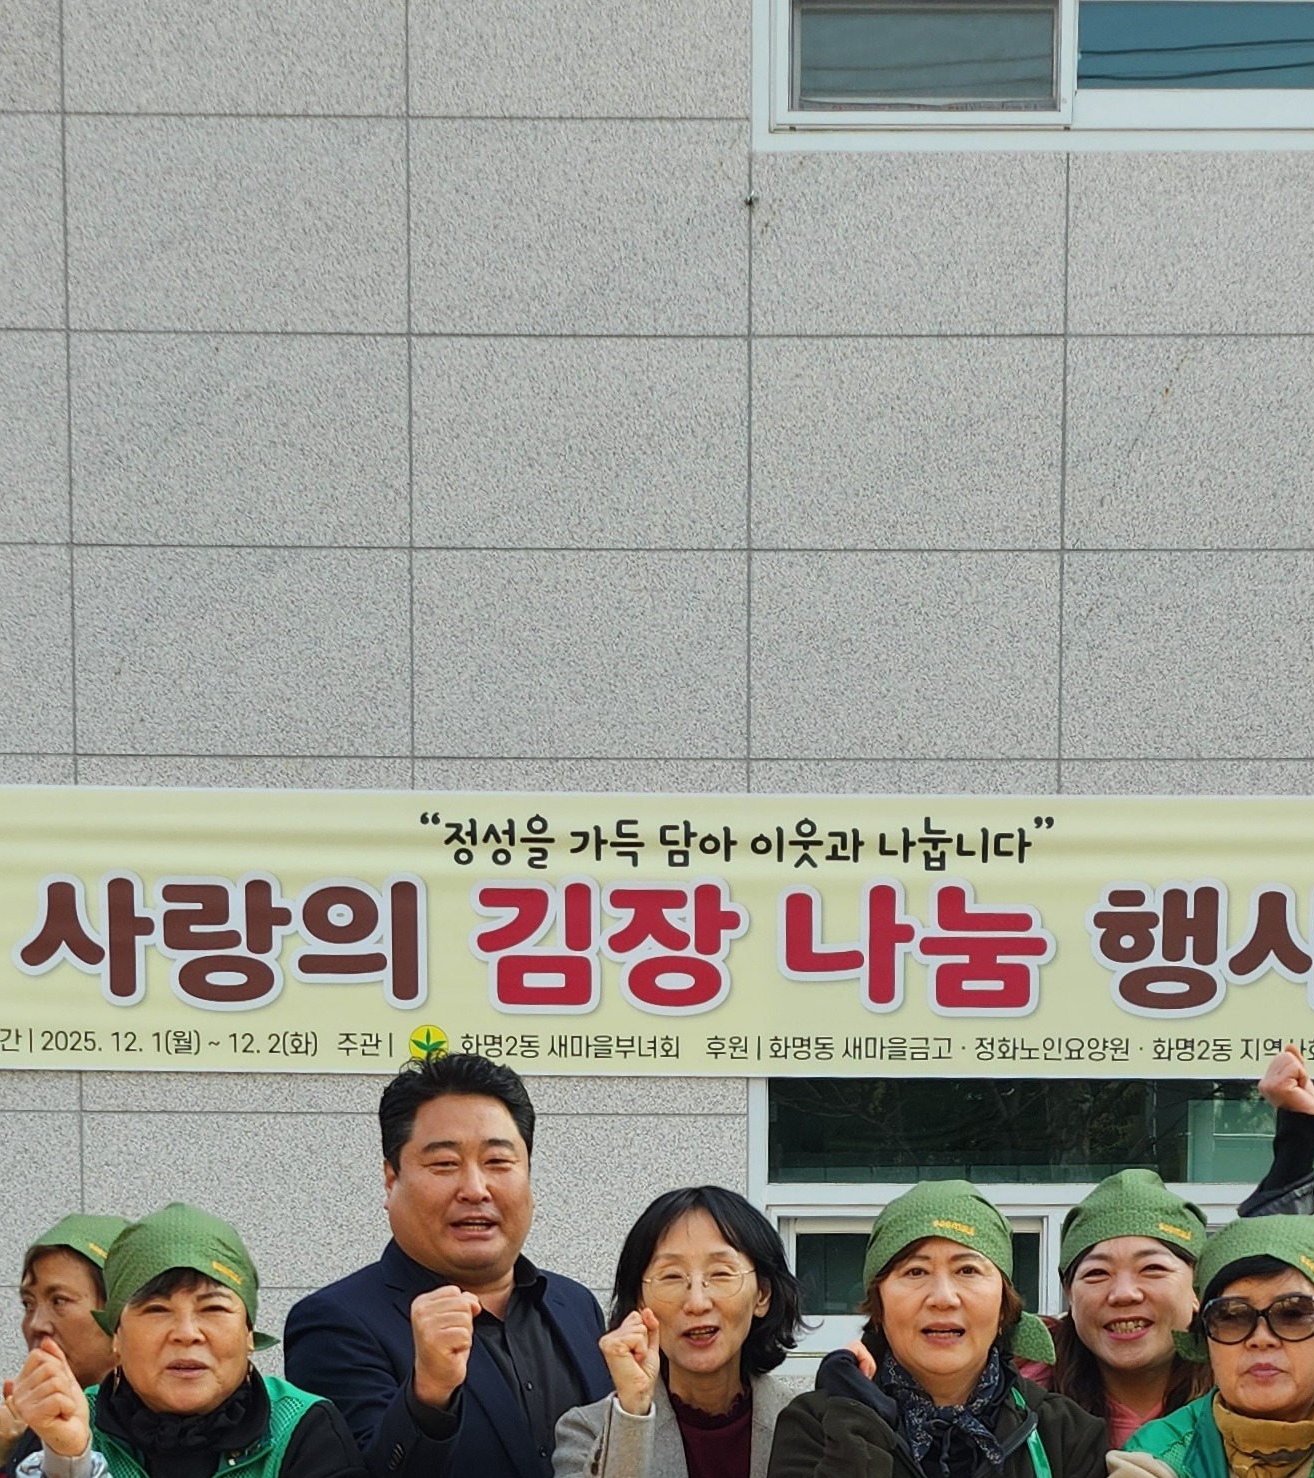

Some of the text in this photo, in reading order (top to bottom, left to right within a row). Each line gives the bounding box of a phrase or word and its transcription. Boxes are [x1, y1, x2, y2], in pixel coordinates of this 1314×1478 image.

[570, 820, 645, 867] 가득
[660, 820, 738, 867] 담아
[751, 818, 864, 868] 이웃과
[21, 878, 418, 1002] 사랑의
[477, 883, 740, 1007] 김장
[786, 884, 1047, 1008] 나눔
[41, 1031, 101, 1051] 2025.
[112, 1032, 142, 1051] 12.
[153, 1030, 200, 1055] 1(월)
[229, 1033, 260, 1053] 12.
[269, 1031, 317, 1056] 2(화)
[338, 1033, 679, 1059] 주관 화명2동 새마을부녀회
[706, 1036, 747, 1059] 후원
[770, 1036, 834, 1060] 화명동
[842, 1037, 951, 1060] 새마을금고
[975, 1037, 1129, 1061] 정화노인요양원
[1153, 1038, 1232, 1061] 화명2동
